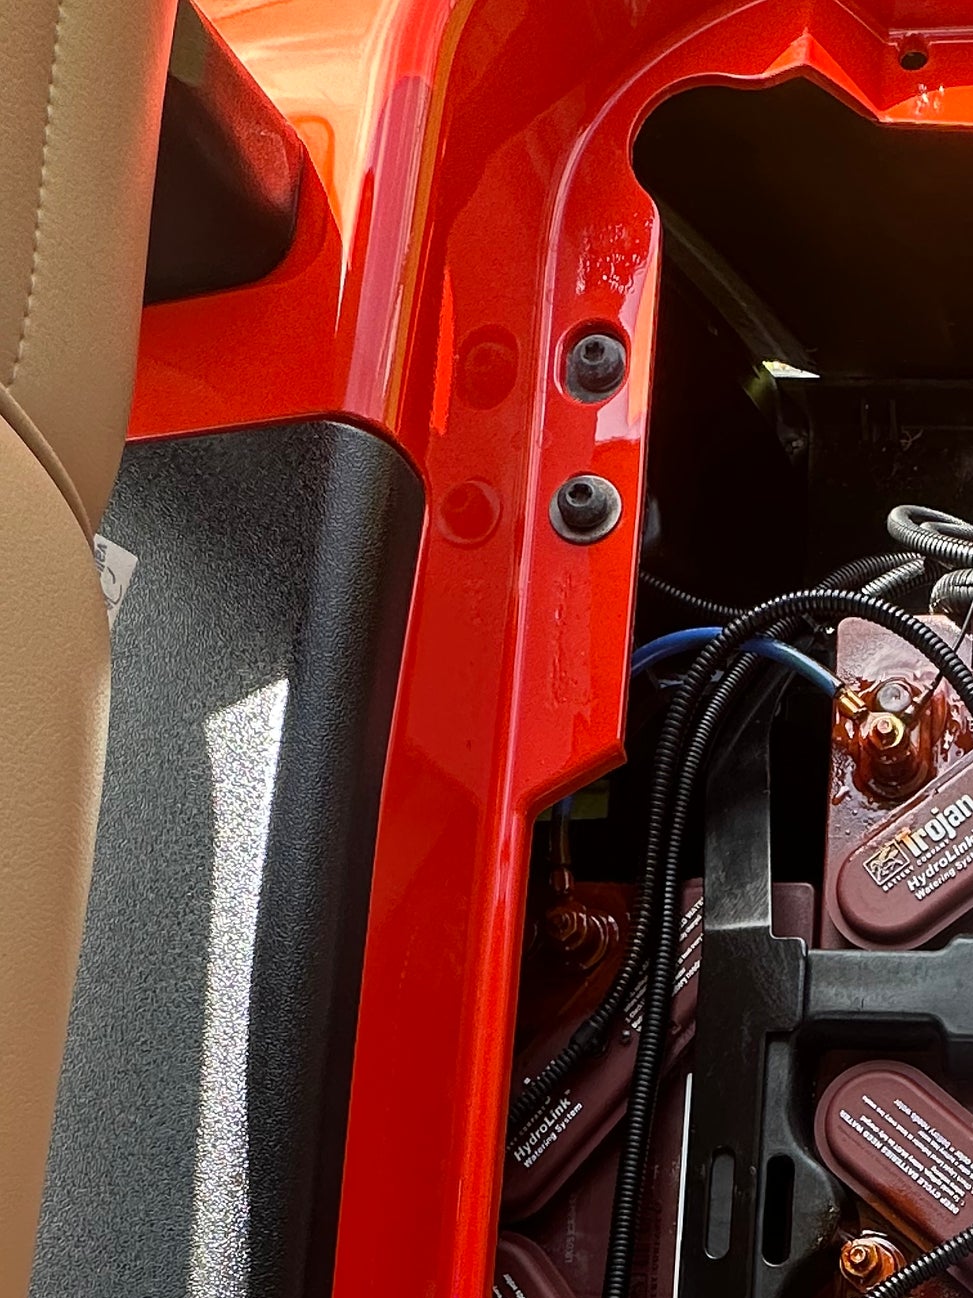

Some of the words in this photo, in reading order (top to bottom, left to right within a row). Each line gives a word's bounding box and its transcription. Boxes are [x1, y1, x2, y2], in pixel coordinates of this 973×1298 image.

[883, 865, 914, 892] BATTERY
[917, 838, 950, 866] COMPANY
[915, 870, 955, 900] Watering
[514, 1098, 571, 1161] HydroLink
[524, 1132, 557, 1167] Watering
[555, 1103, 582, 1132] System
